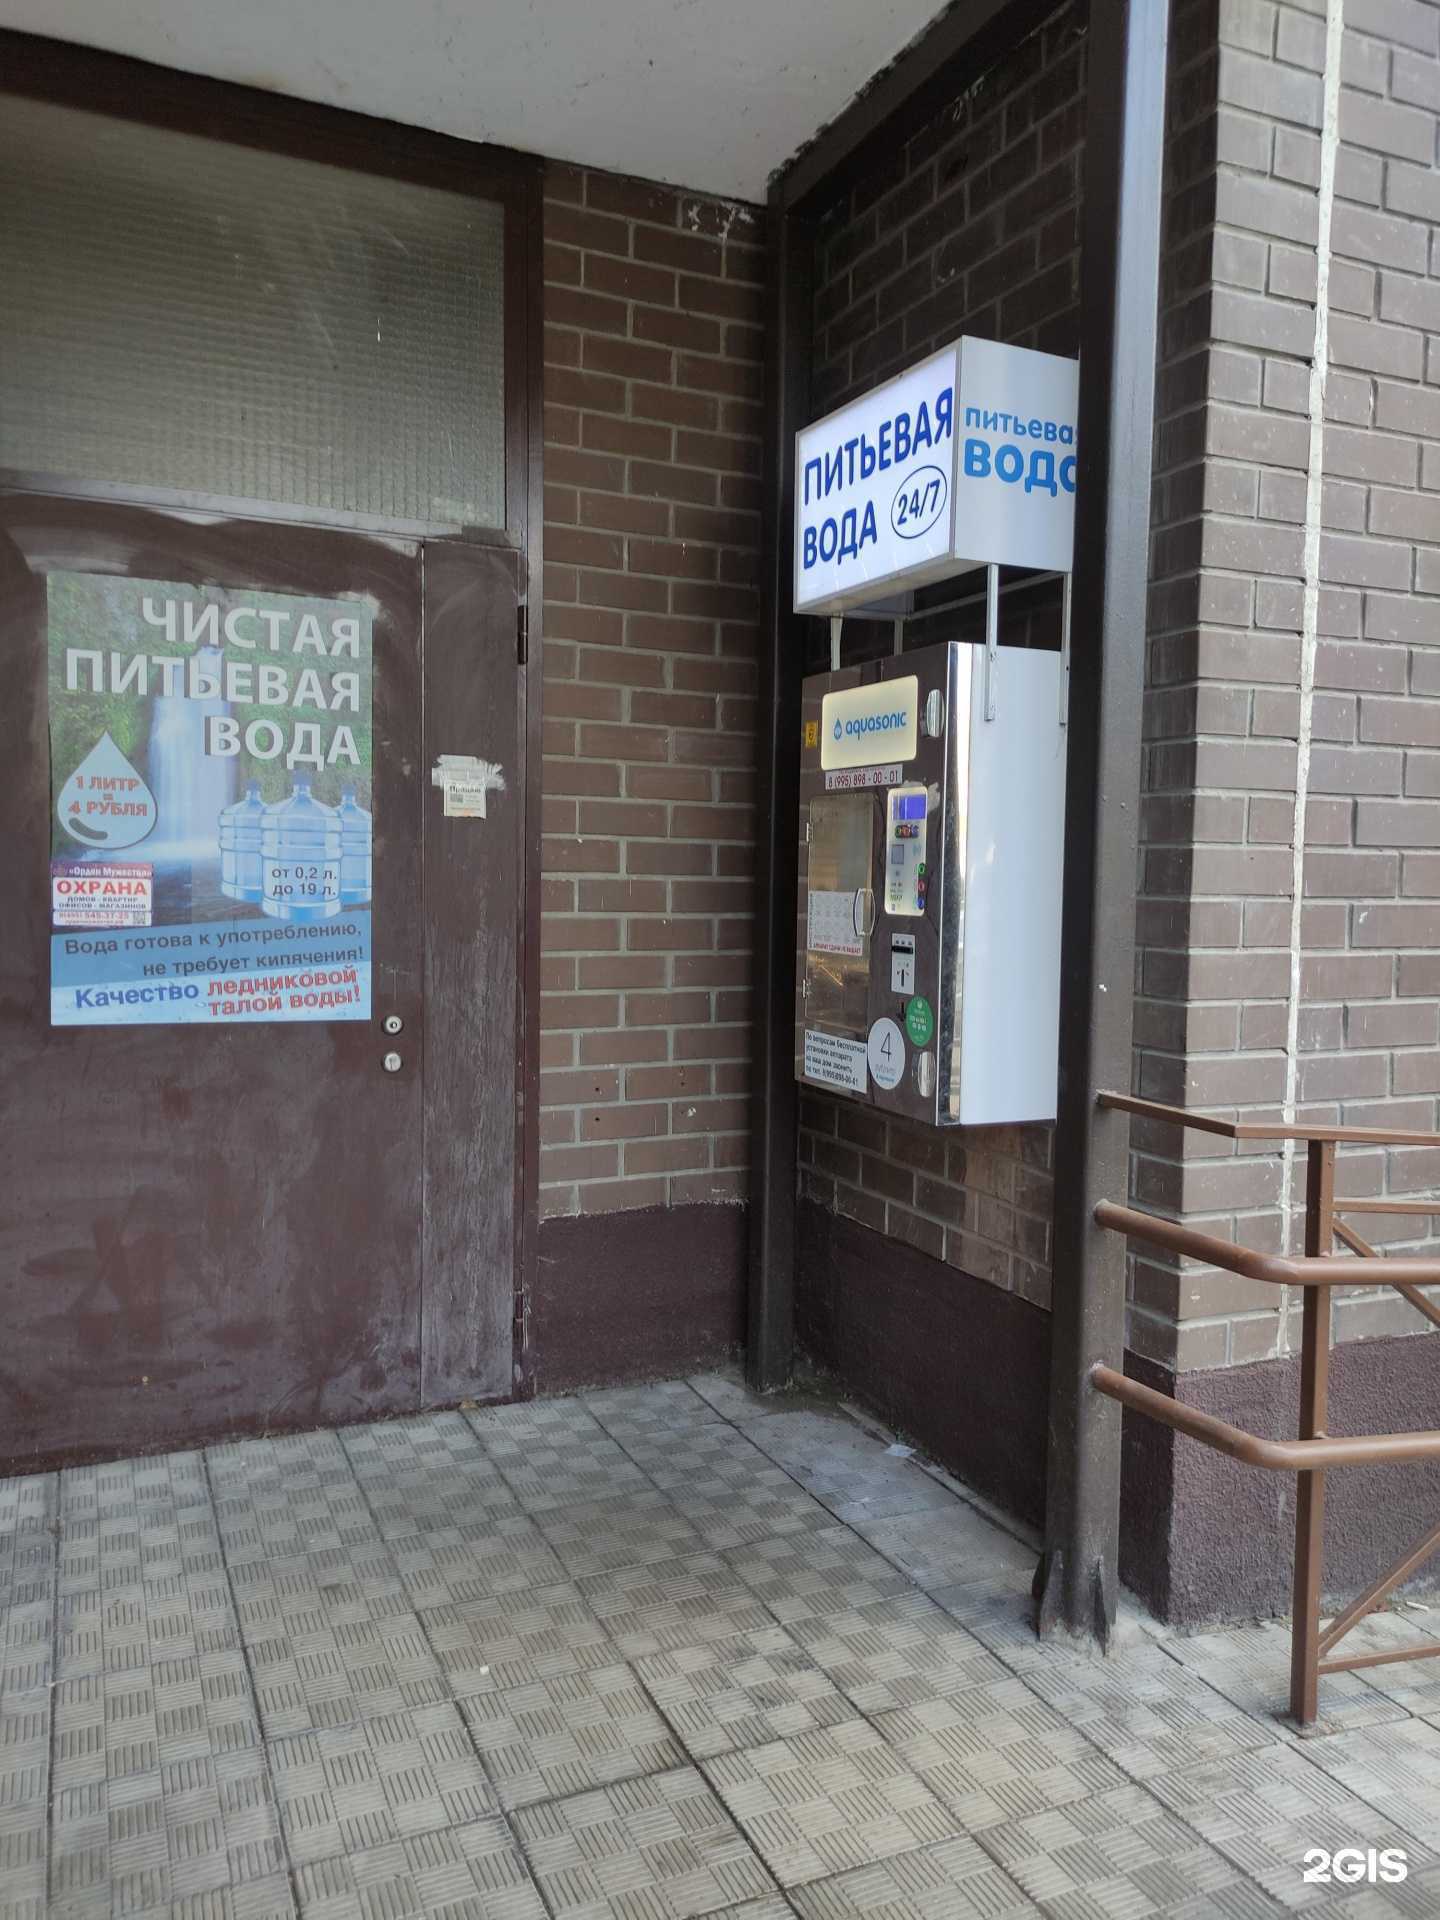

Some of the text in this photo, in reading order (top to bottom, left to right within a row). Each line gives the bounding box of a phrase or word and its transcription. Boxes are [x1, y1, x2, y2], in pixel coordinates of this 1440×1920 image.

[965, 407, 1077, 445] питьева
[804, 387, 953, 506] ПИТЬЕВАЯ
[897, 479, 940, 526] 24/7
[803, 500, 877, 570] ВОДА
[142, 597, 360, 658] ЧИСТАЯ
[66, 647, 360, 713] ПИТЬЕВАЯ
[845, 711, 906, 740] aquasonic
[207, 715, 361, 772] ВОДА
[76, 776, 140, 790] 1 ЛИТР
[828, 776, 833, 788] 8
[873, 771, 882, 784] 00
[889, 770, 898, 782] 01
[68, 801, 147, 816] 4 РУБЛЯ
[56, 880, 147, 895] ОХРАНА
[272, 867, 337, 881] от 0,2 л.
[273, 883, 336, 897] до 19 л.
[65, 923, 362, 956] Вода готова к употреблению,
[143, 948, 363, 976] не требует кипячения!
[75, 965, 358, 1009] Качество ледниковой
[207, 985, 361, 1017] талой воды!
[880, 1031, 892, 1061] 4
